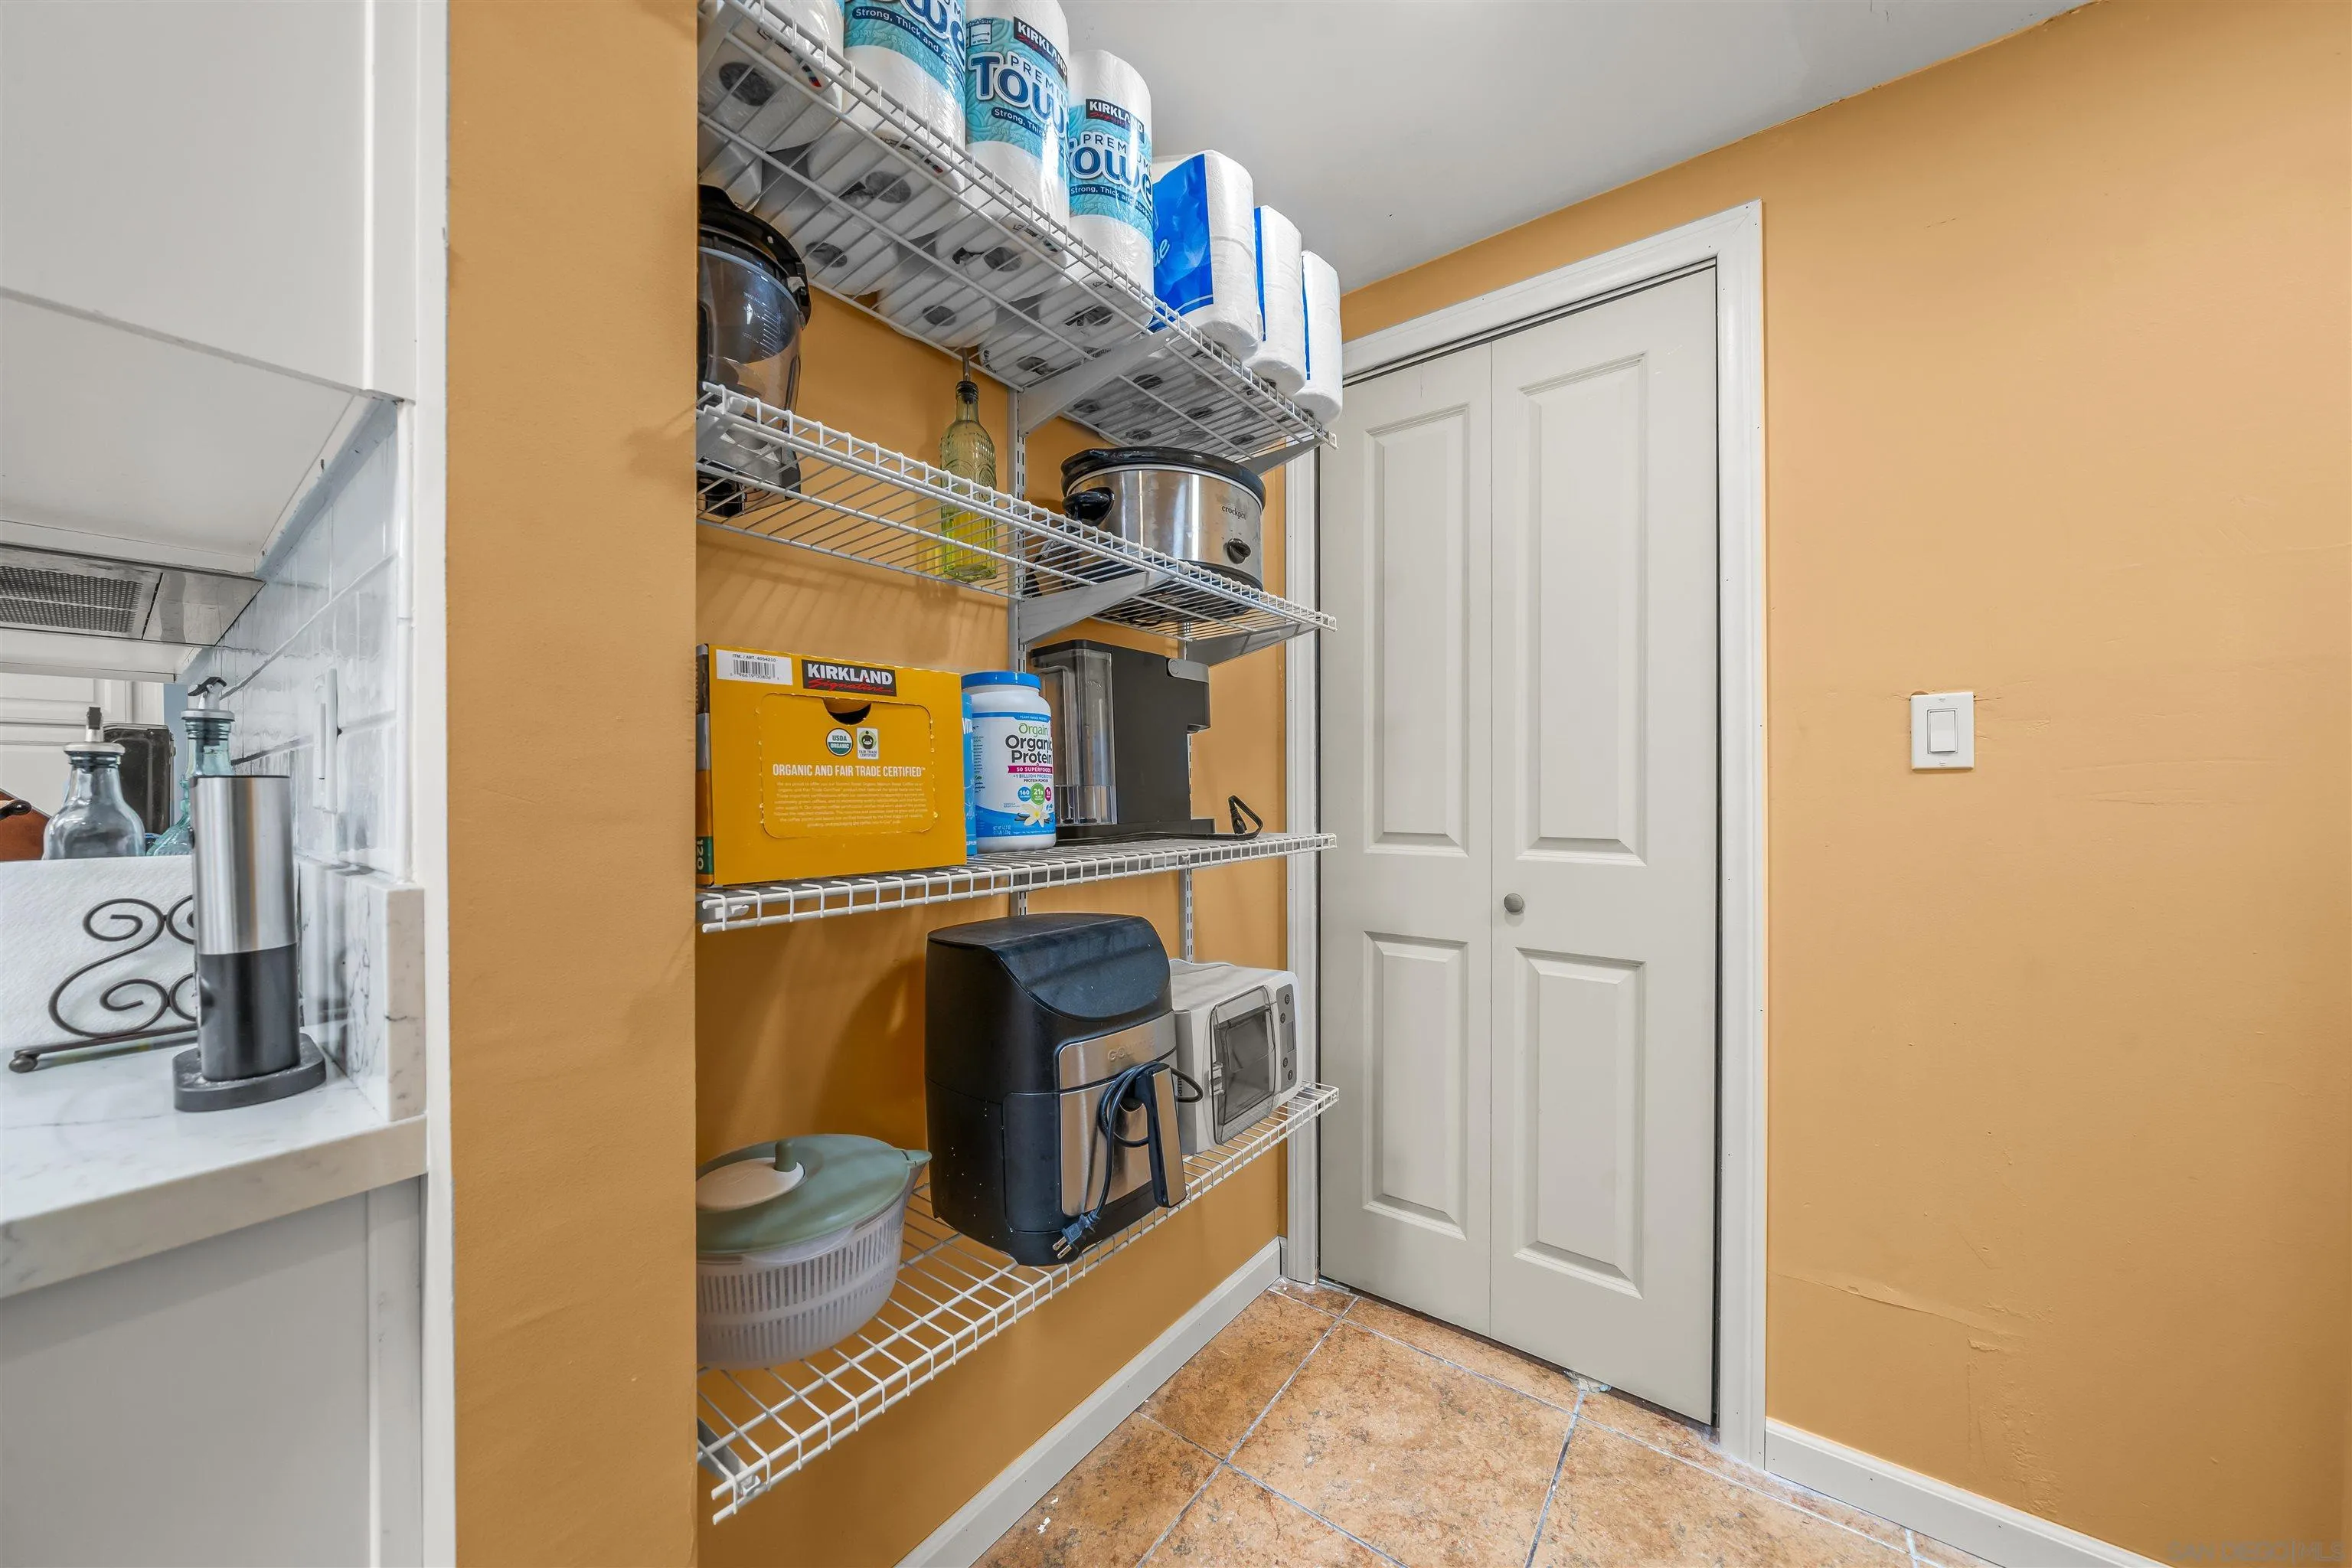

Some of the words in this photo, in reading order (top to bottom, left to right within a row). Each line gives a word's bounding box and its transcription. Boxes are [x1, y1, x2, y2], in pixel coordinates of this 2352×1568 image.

[855, 8, 893, 21] Strong,
[896, 15, 921, 38] Thick
[923, 37, 939, 52] and
[1018, 21, 1067, 76] KIRKLAND
[995, 109, 1026, 126] Strong,
[1070, 186, 1098, 194] Strong,
[1100, 186, 1120, 198] Thick
[807, 663, 893, 685] KIRKLAND
[1018, 723, 1048, 737] Orgain
[1011, 750, 1052, 764] Protein
[773, 763, 813, 776] ORGANIC
[815, 765, 833, 776] AND
[835, 765, 854, 777] FAIR
[855, 766, 881, 777] TRADE
